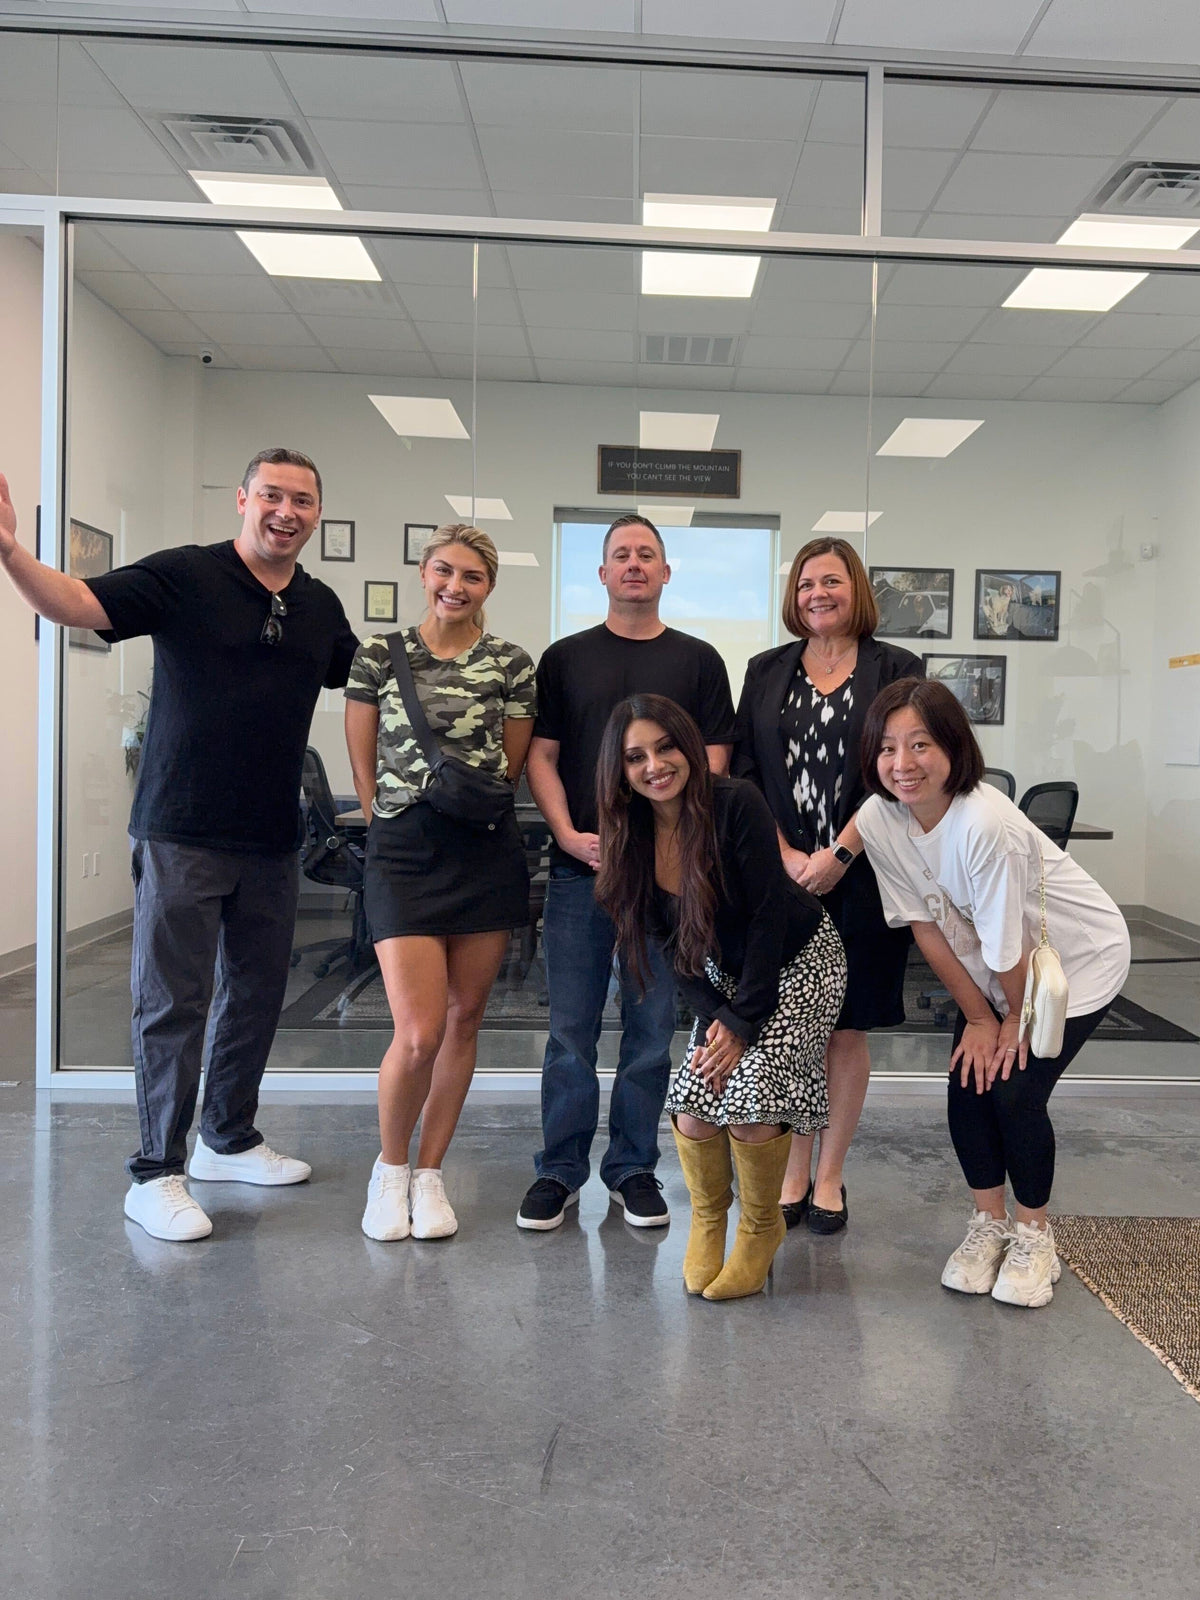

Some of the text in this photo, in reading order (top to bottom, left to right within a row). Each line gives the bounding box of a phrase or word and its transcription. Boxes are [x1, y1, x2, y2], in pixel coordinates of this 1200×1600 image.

[632, 462, 653, 470] DON'T
[626, 472, 641, 480] YOU
[643, 473, 663, 481] CAN'T
[678, 474, 691, 482] THE
